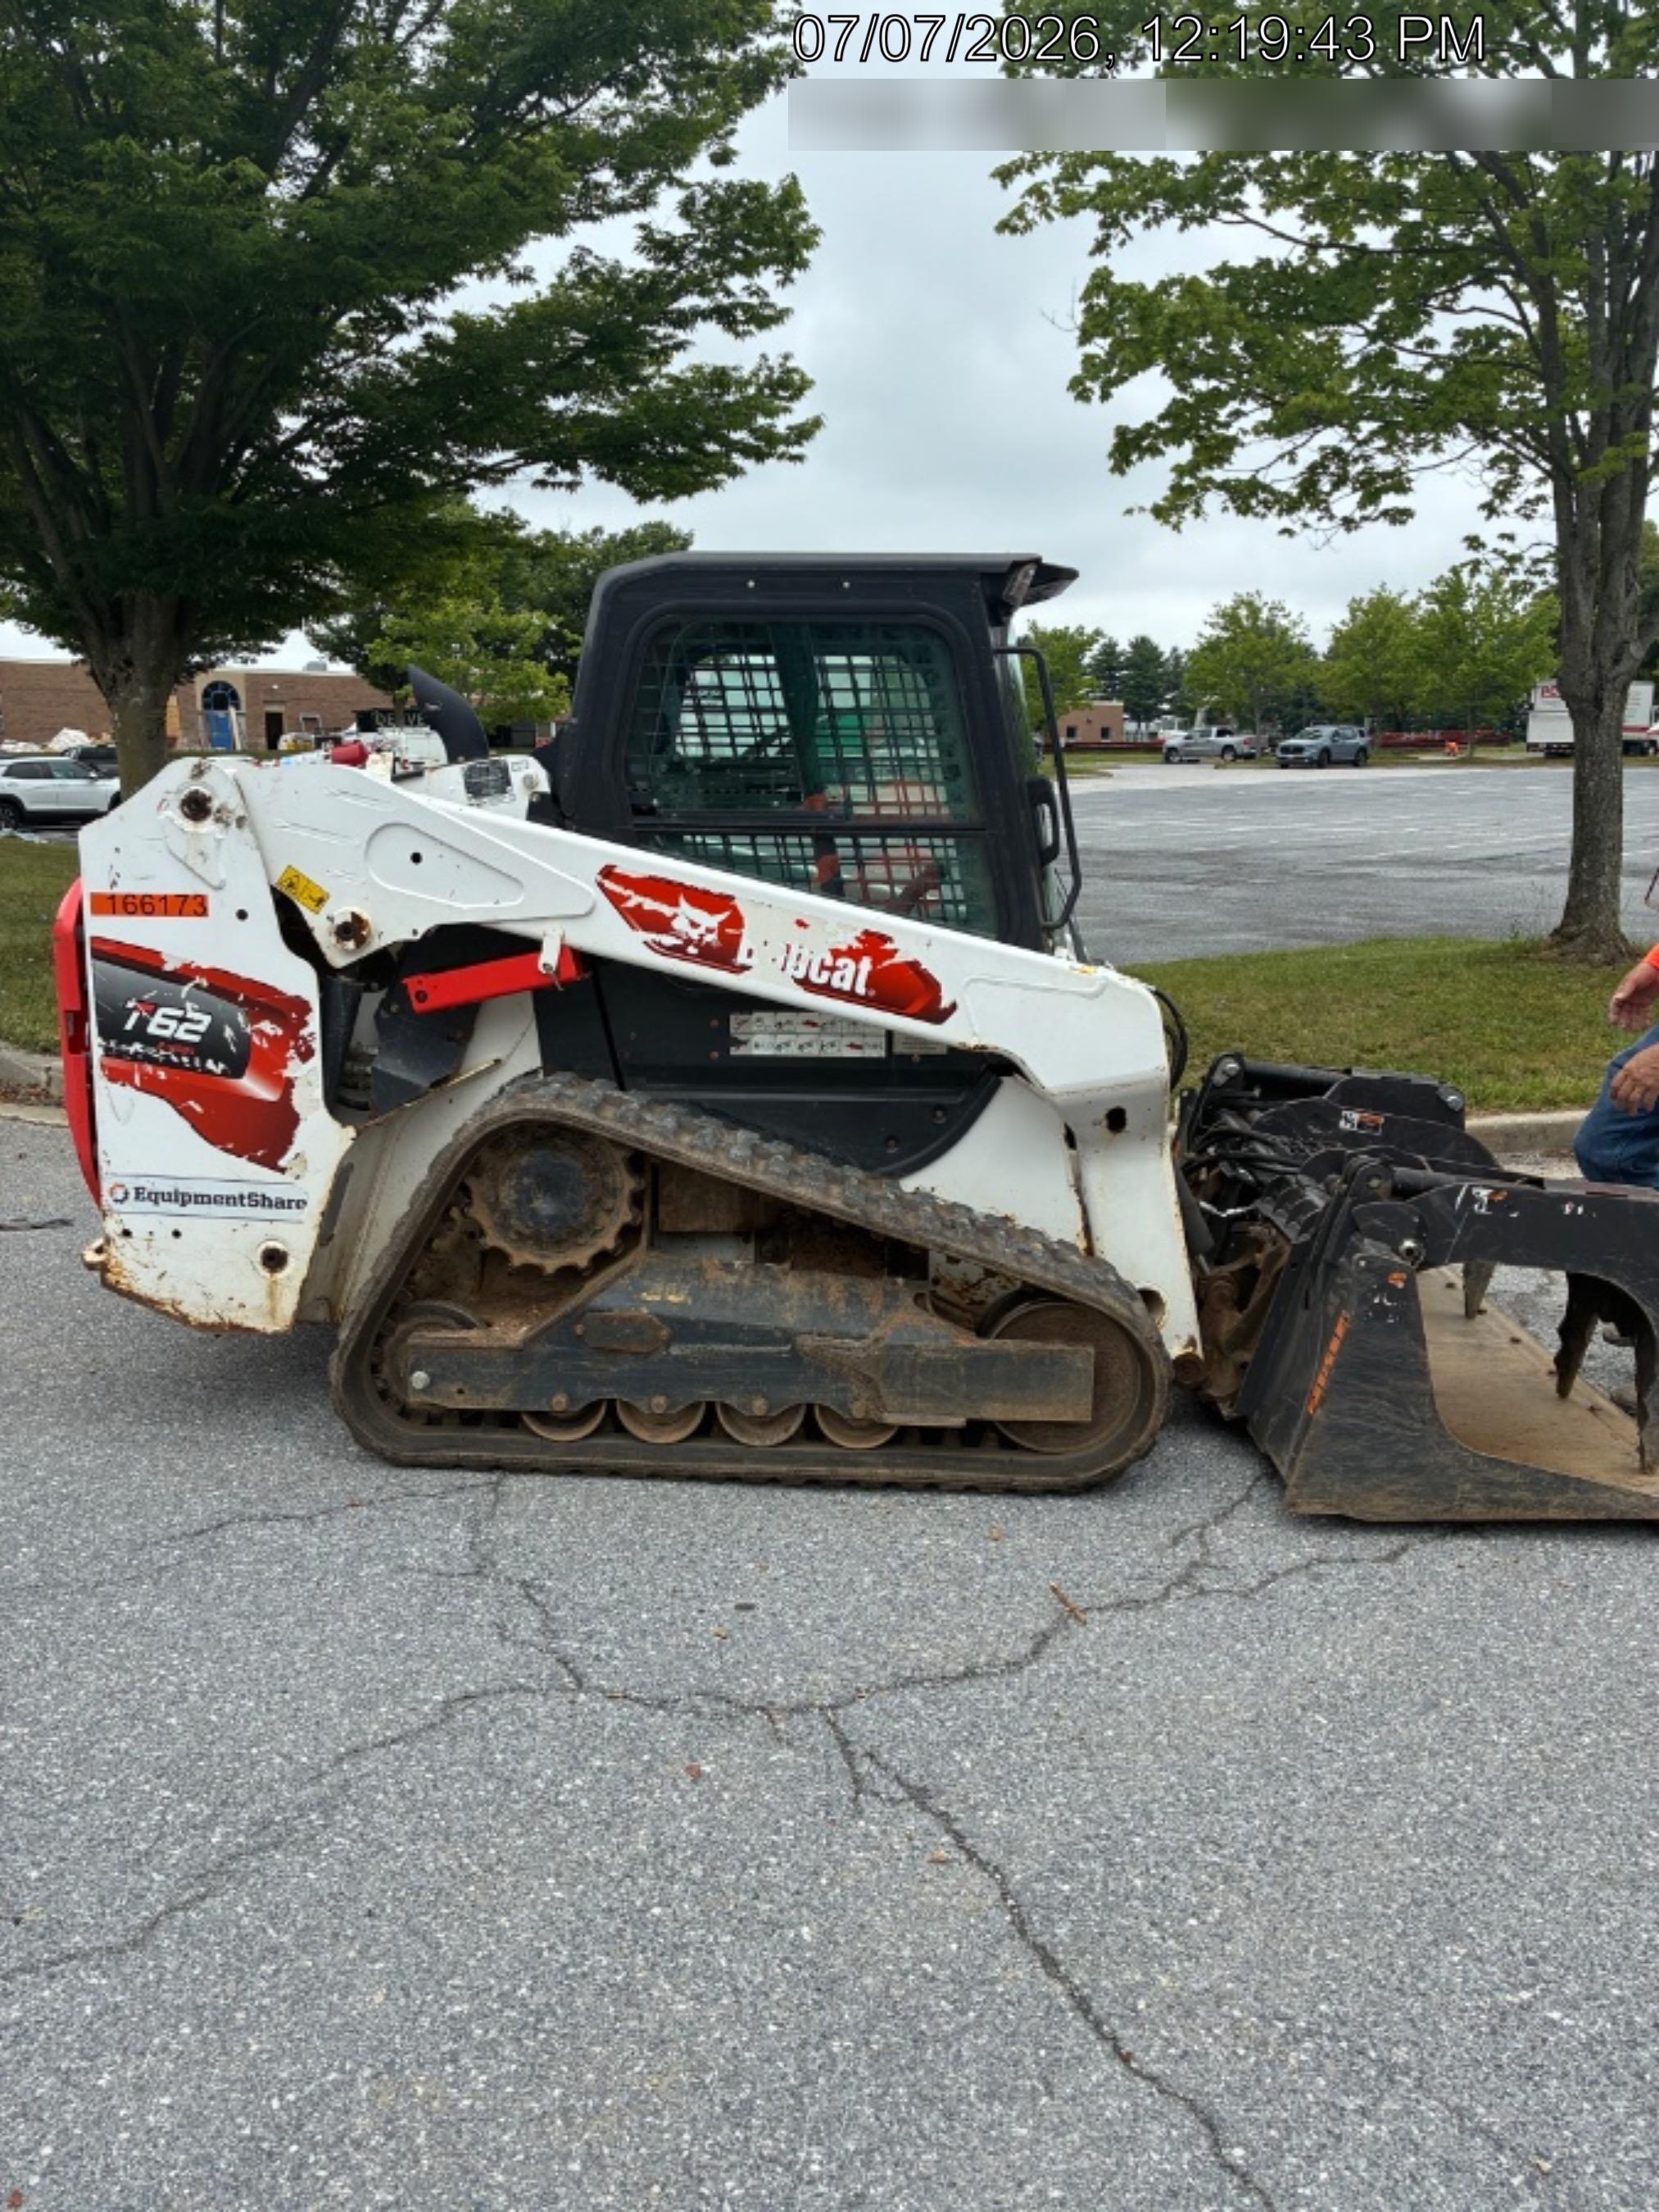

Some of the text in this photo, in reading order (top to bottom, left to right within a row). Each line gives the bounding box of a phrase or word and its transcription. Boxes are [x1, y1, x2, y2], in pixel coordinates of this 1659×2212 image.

[107, 894, 206, 916] 166173
[125, 999, 211, 1042] T62
[134, 1186, 307, 1210] EquipmentShare
